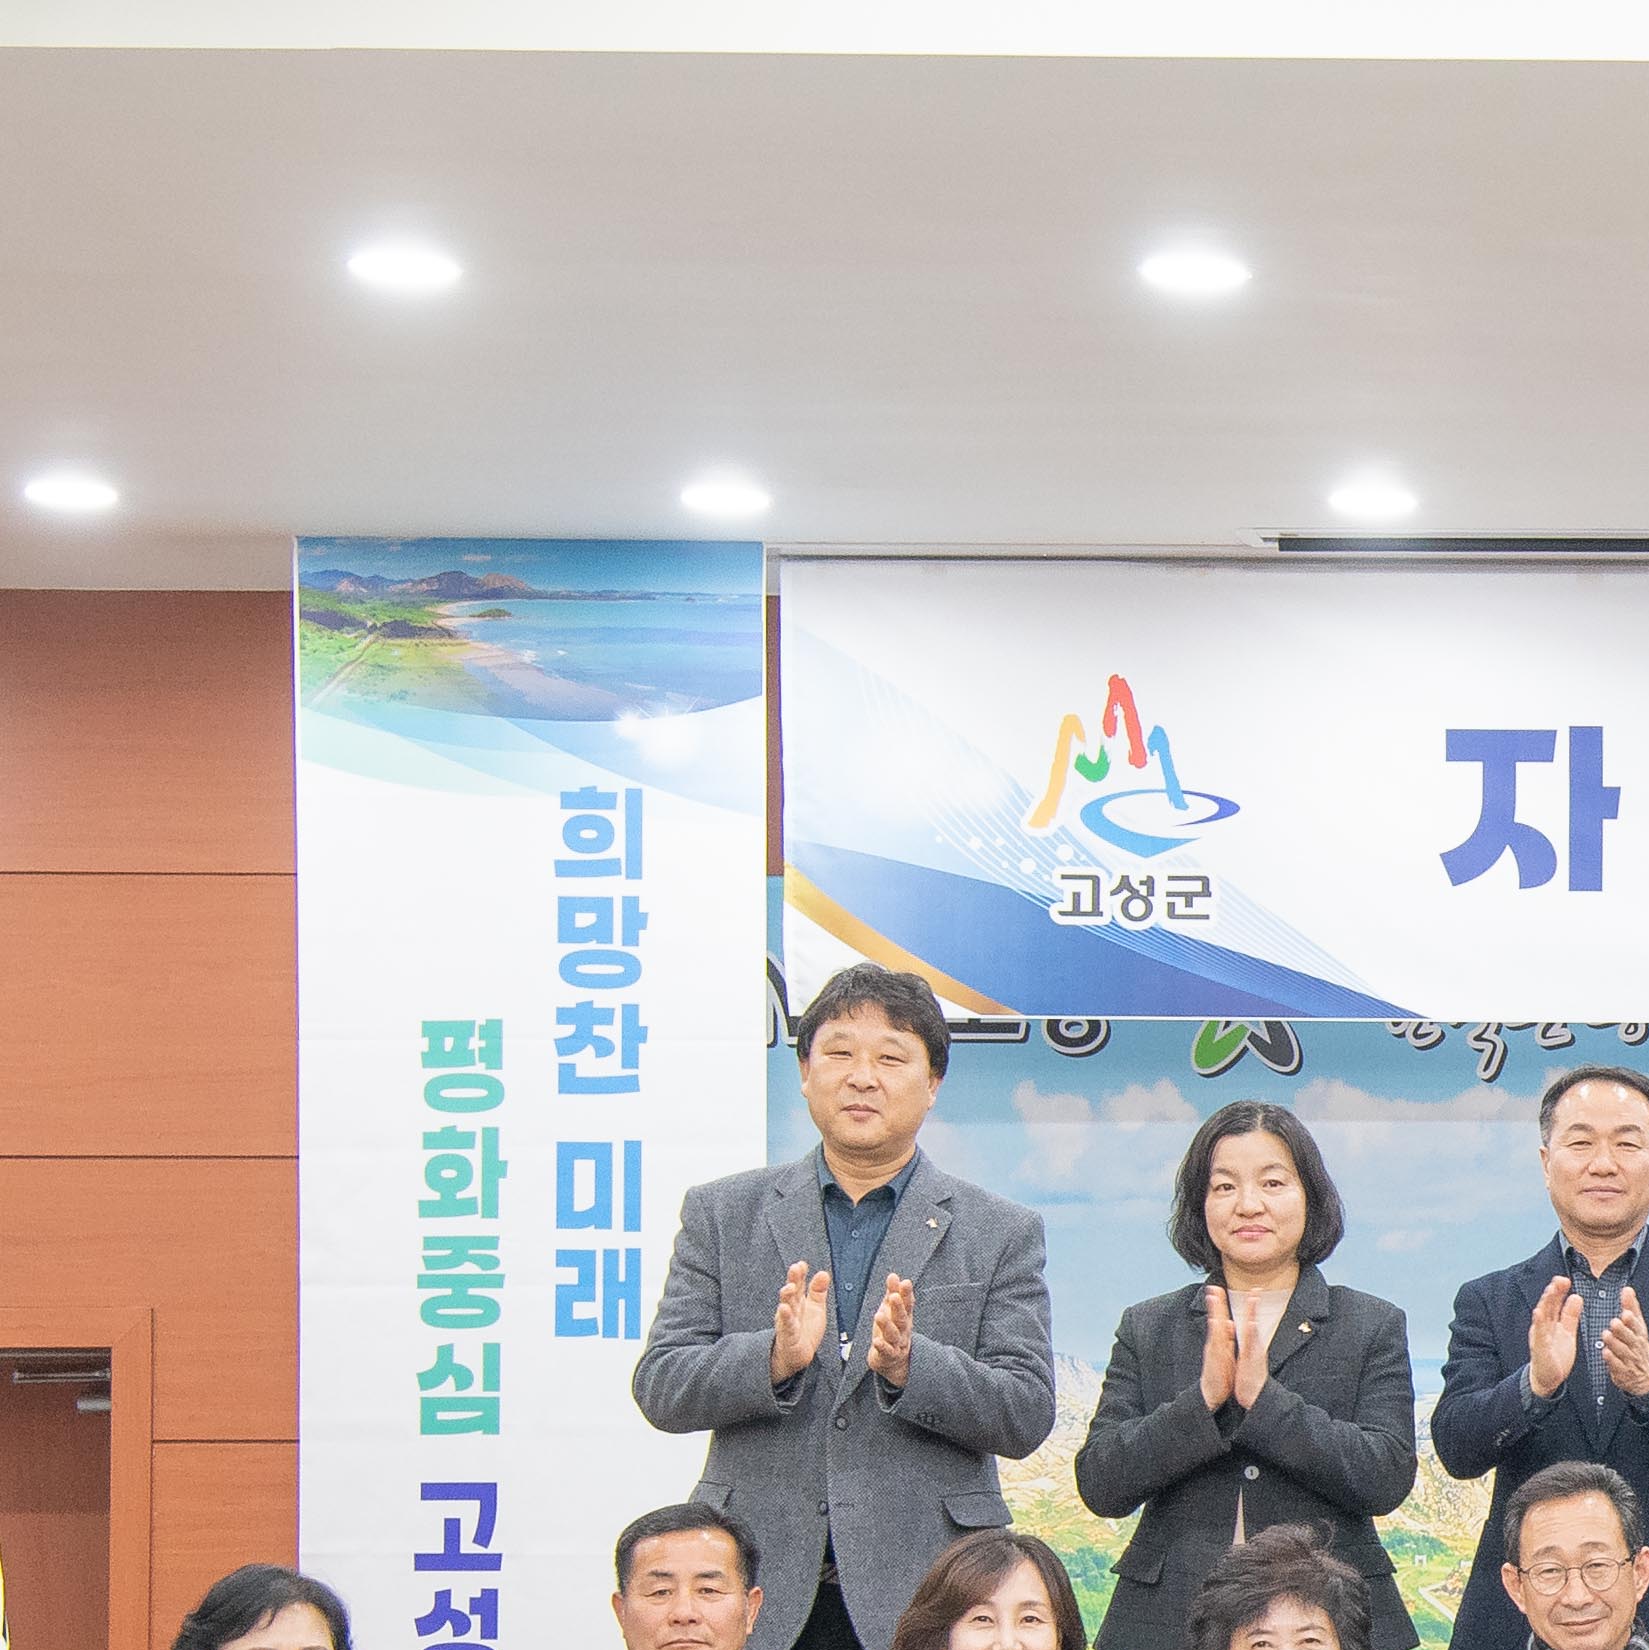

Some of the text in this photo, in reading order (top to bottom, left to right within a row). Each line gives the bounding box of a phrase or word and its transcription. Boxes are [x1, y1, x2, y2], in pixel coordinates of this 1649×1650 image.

[555, 787, 647, 1339] 희망찬 미래
[1058, 874, 1212, 921] 고성군
[417, 1019, 507, 1435] 평화중심
